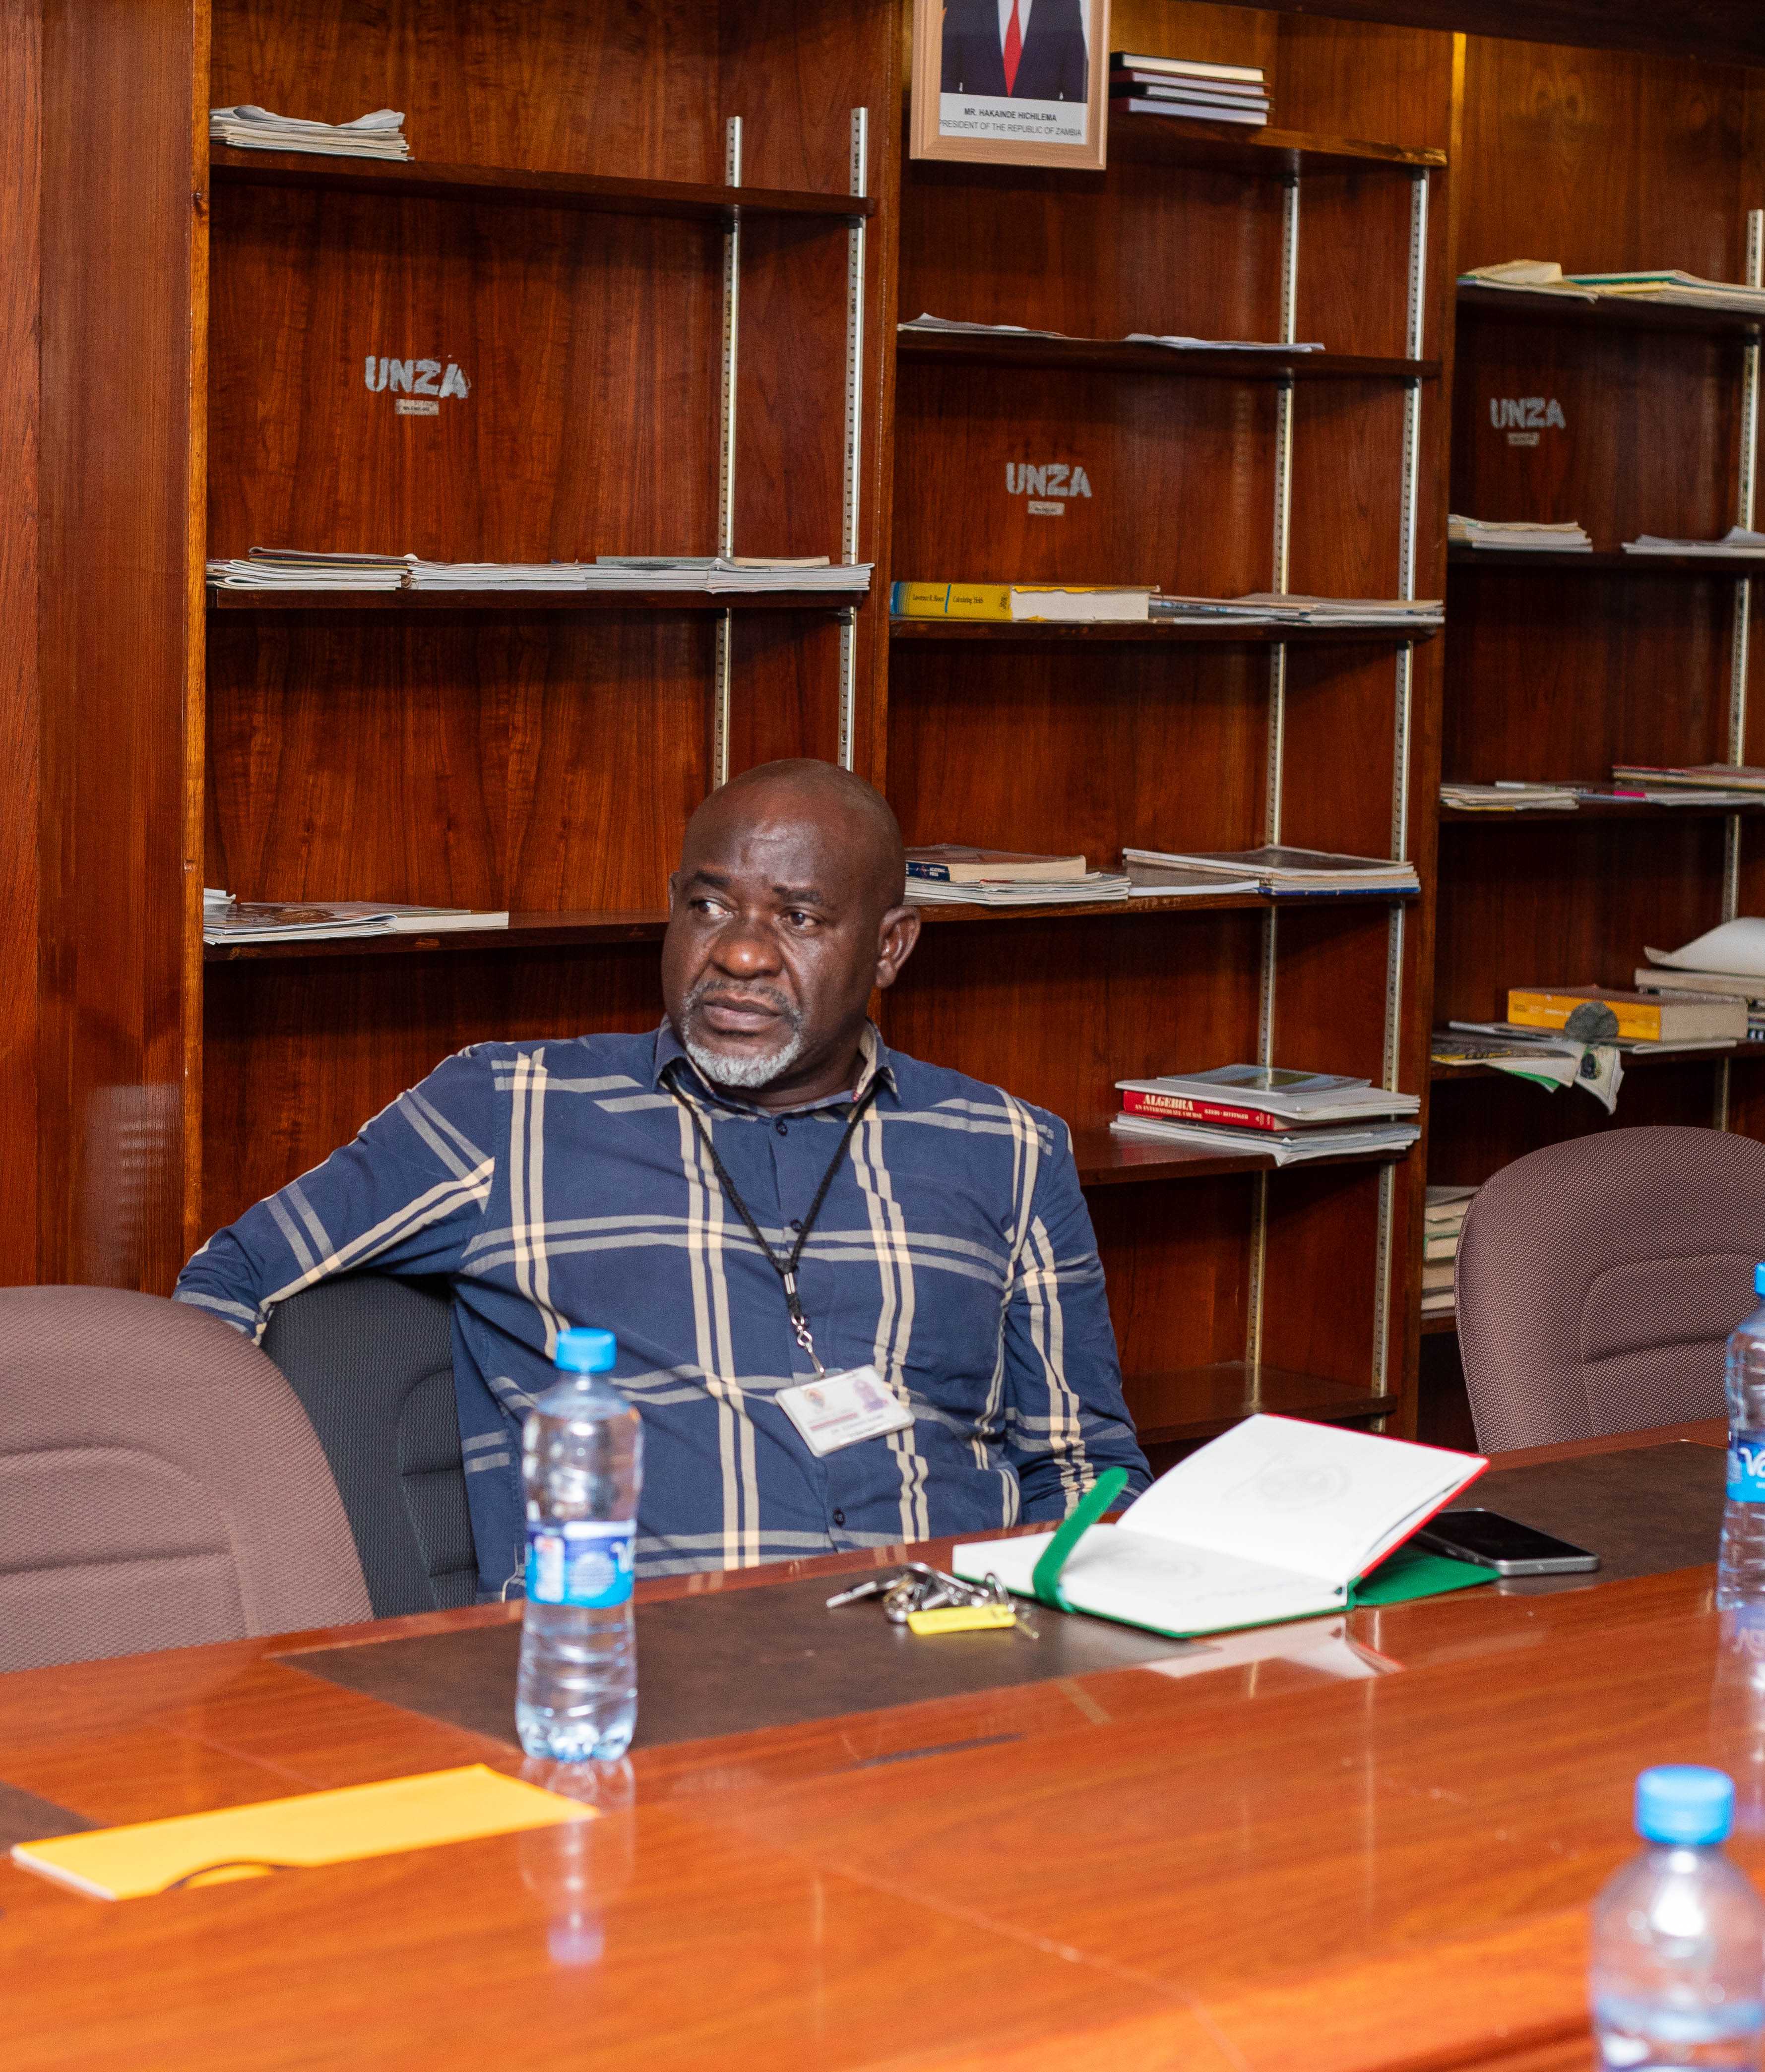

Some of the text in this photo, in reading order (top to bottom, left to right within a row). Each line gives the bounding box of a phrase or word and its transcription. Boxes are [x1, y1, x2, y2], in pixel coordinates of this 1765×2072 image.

[964, 107, 1057, 122] MR. HAKAINDE HICHILEMA
[992, 122, 1006, 131] THE
[1007, 124, 1042, 134] REPUBLIC
[1055, 127, 1082, 136] ZAMBIA
[365, 355, 469, 400] UNZA
[1490, 397, 1566, 429] UNZA
[1006, 462, 1092, 498] UNZA
[1143, 1094, 1194, 1111] ALGEBRA
